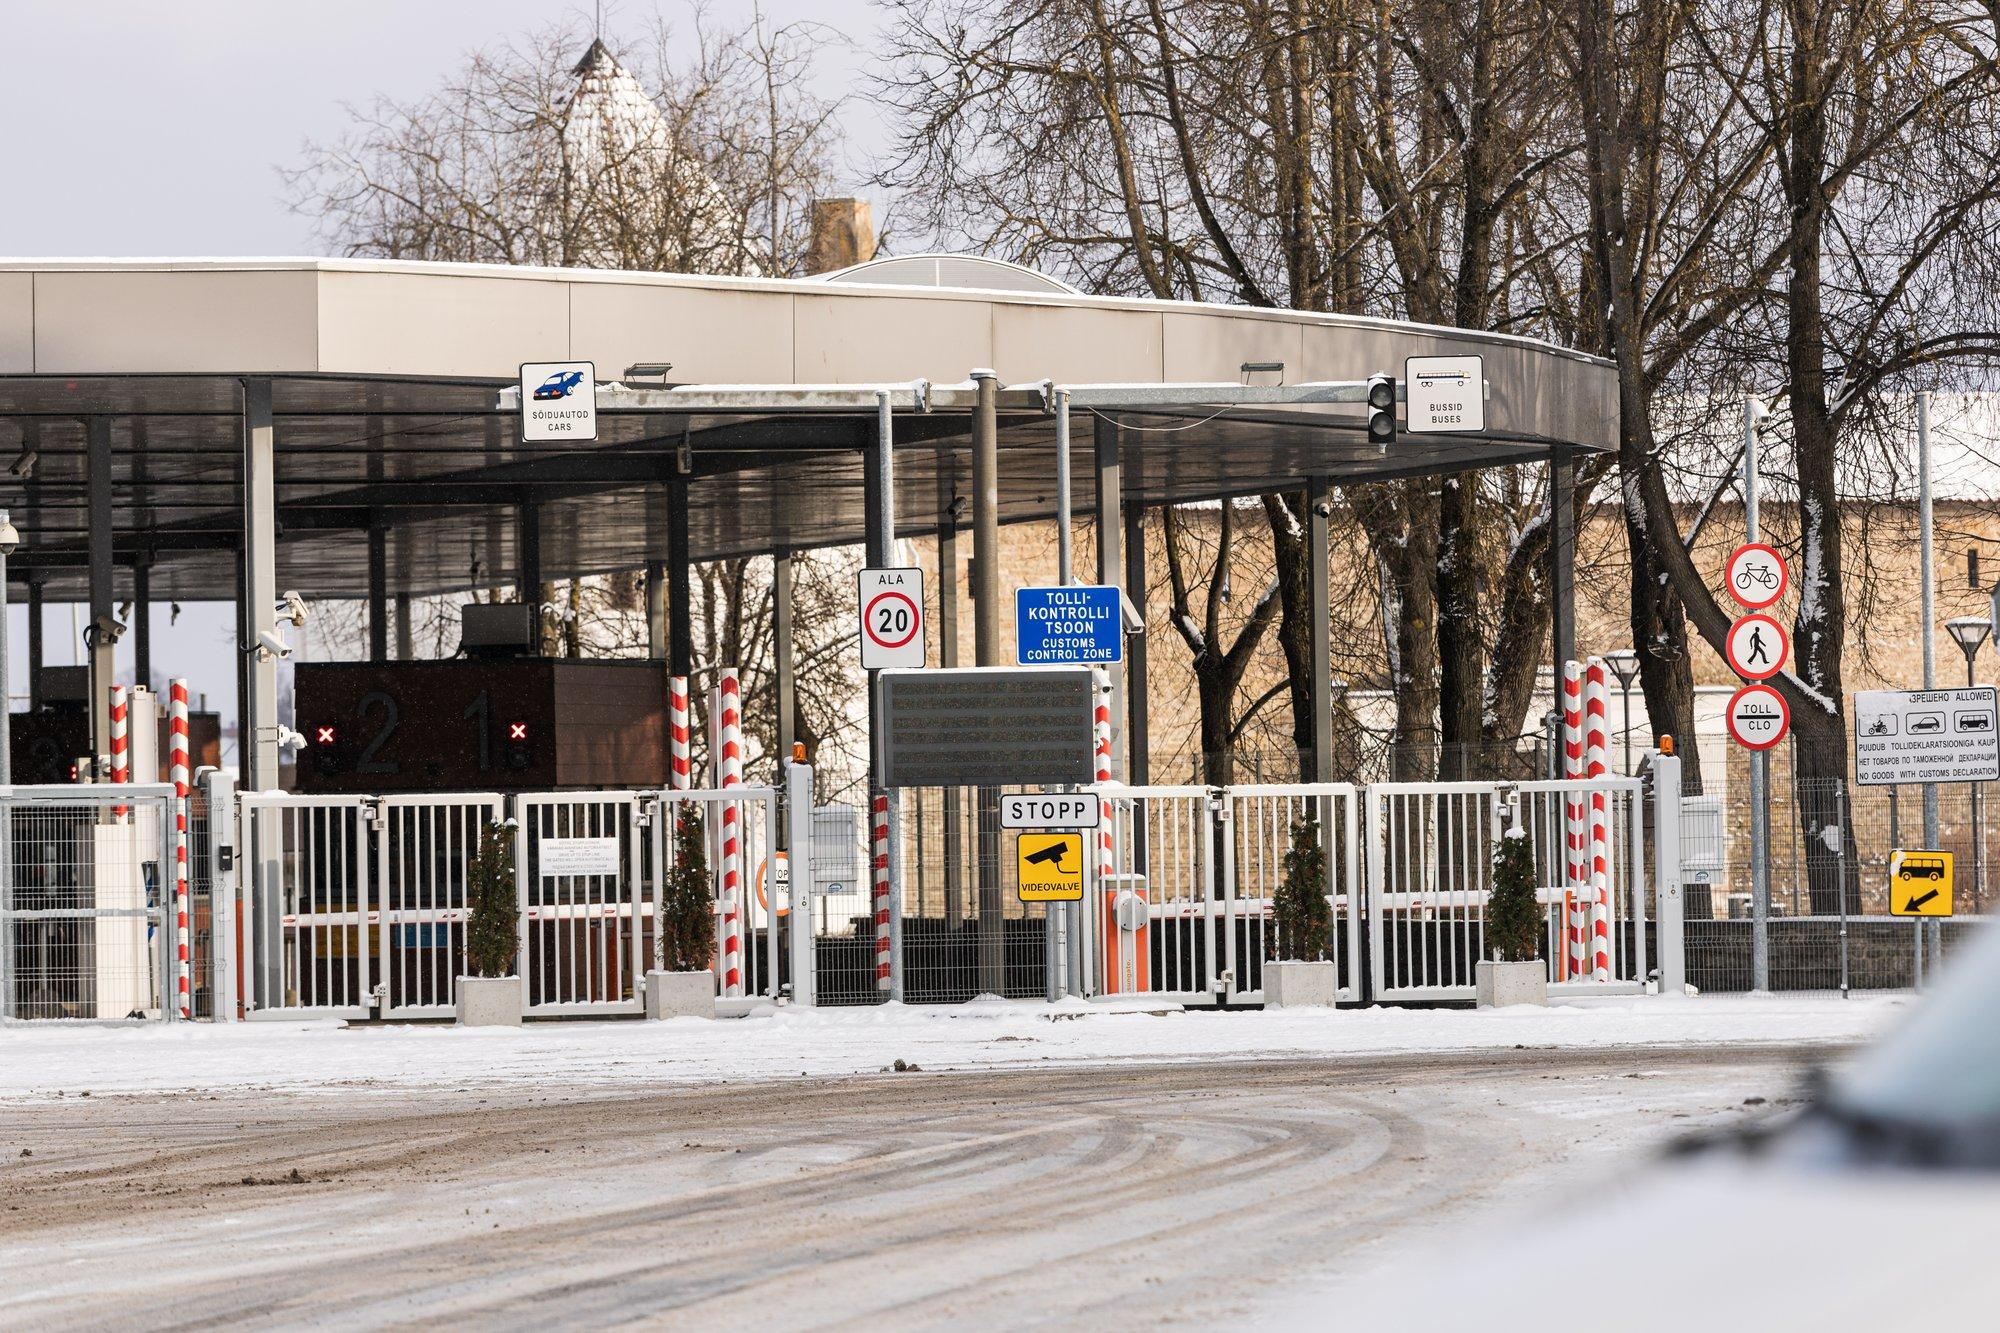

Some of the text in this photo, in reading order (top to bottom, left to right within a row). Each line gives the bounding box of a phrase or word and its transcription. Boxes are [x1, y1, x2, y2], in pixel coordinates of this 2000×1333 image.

[1430, 403, 1462, 411] BUSSID
[532, 409, 589, 419] SÕIDUAUTOD
[1431, 415, 1461, 423] BUSES
[548, 423, 572, 431] CARS
[878, 574, 904, 585] ALA
[1046, 592, 1091, 604] TOLLI-
[1029, 606, 1109, 620] KONTROLLI
[879, 608, 908, 632] 20
[1045, 621, 1094, 634] TSOON
[1042, 638, 1095, 648] CUSTOMS
[1027, 648, 1112, 660] CONTROL ZONE
[1909, 691, 1993, 703] ЗРЕШЕНО ALLOWED
[1743, 704, 1771, 714] TOLL
[1748, 720, 1771, 730] CLO
[1859, 739, 1996, 752] PUUDUB TOLLIDEKLARATSIOONIGA KAUP
[1859, 753, 1996, 766] НЕТ ТОВАРОВ ПО ТАМОЖЕННОЙ ДЕКЛАРАЦИИ
[1859, 767, 1997, 780] NO GOODS WITH CUSTOMS DECLARATION
[1011, 802, 1085, 819] STOPP
[1021, 882, 1080, 892] VIDEOVALVE
